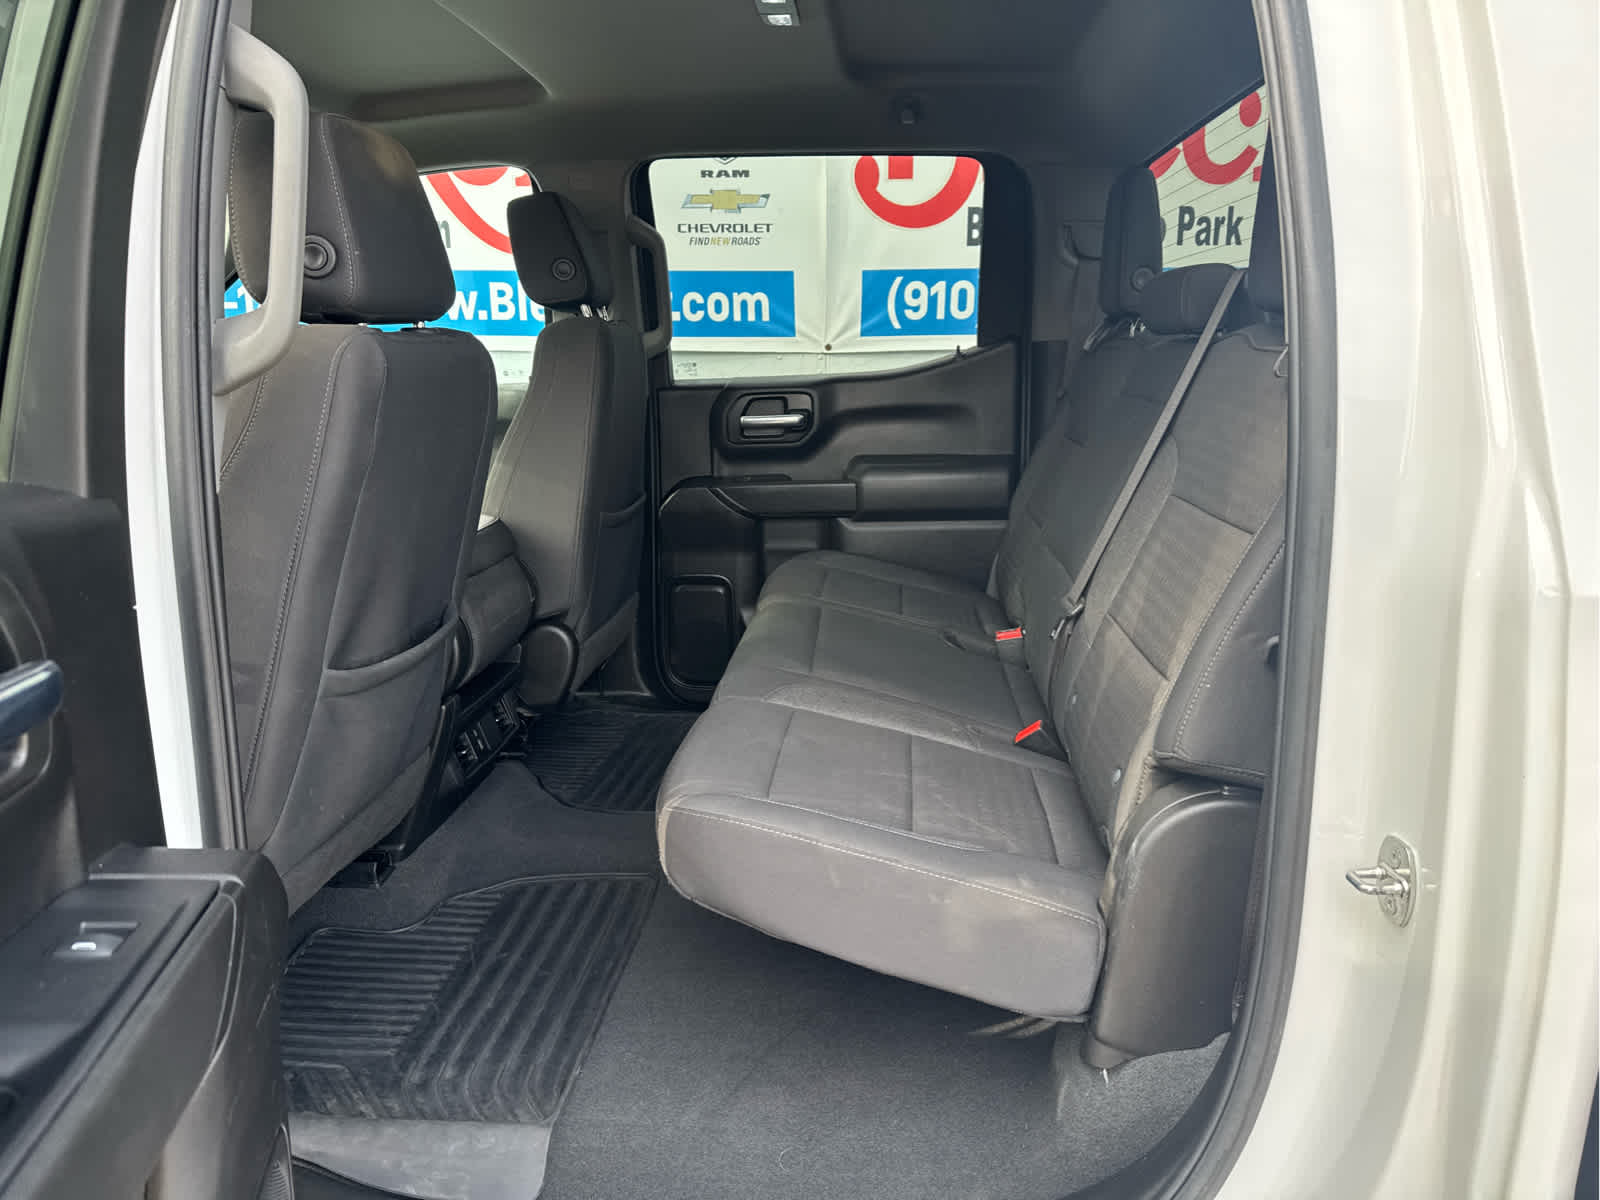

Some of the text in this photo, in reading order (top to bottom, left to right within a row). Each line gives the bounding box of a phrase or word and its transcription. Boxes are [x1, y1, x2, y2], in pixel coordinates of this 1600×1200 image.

[700, 169, 750, 178] RAM
[677, 223, 773, 234] CHEVROLET
[1176, 205, 1243, 246] Park
[670, 291, 770, 322] .com
[887, 276, 978, 329] (910
